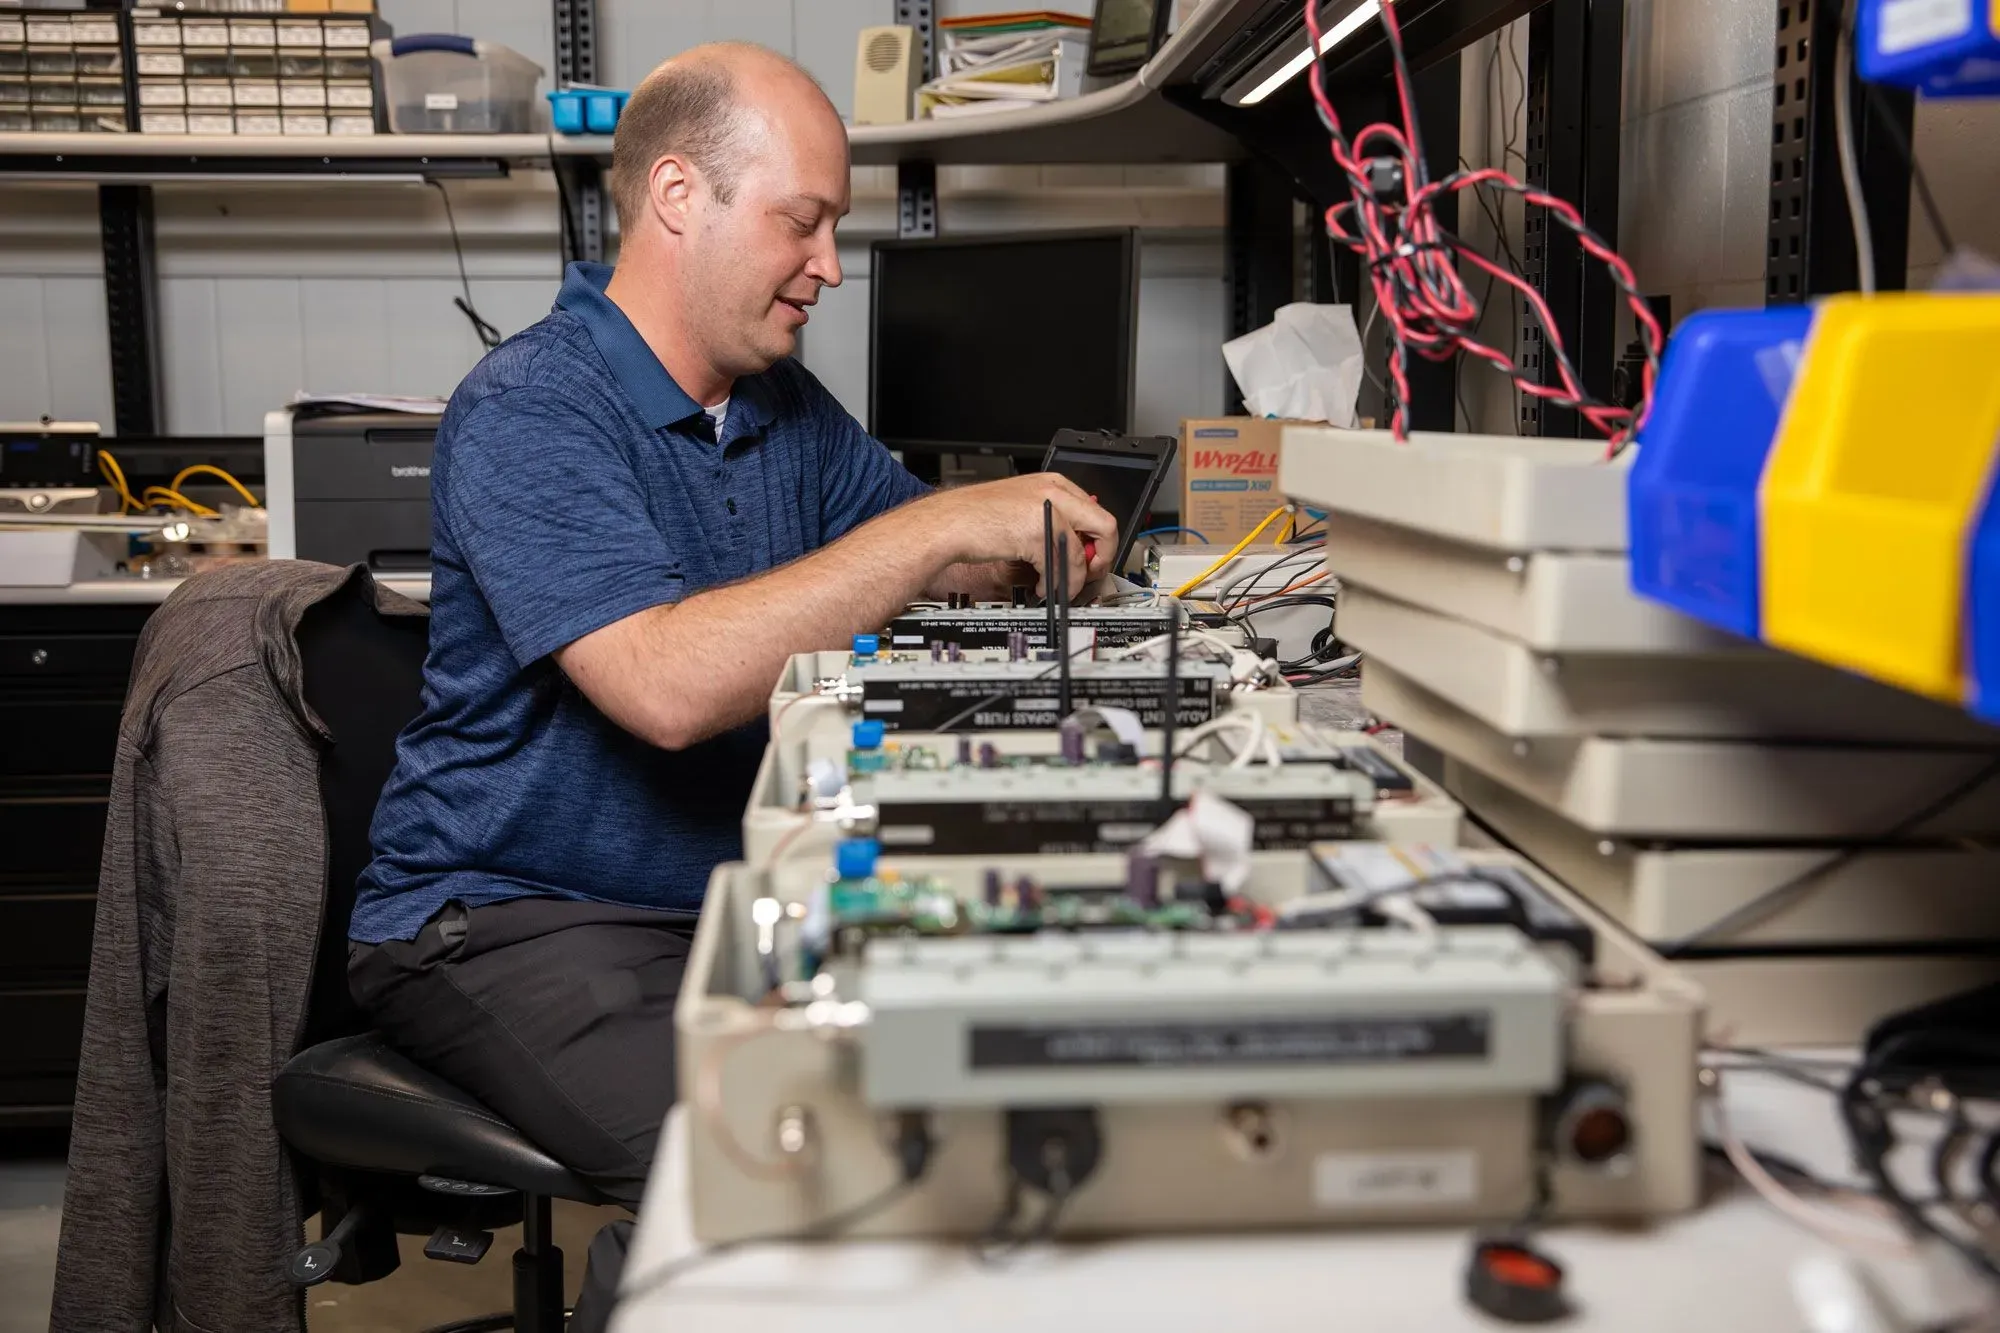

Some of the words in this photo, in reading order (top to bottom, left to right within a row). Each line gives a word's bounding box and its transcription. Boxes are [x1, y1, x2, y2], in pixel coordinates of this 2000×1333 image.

[391, 466, 431, 477] brother
[974, 712, 1011, 725] FILTER
[1142, 711, 1208, 723] ADJAENT
